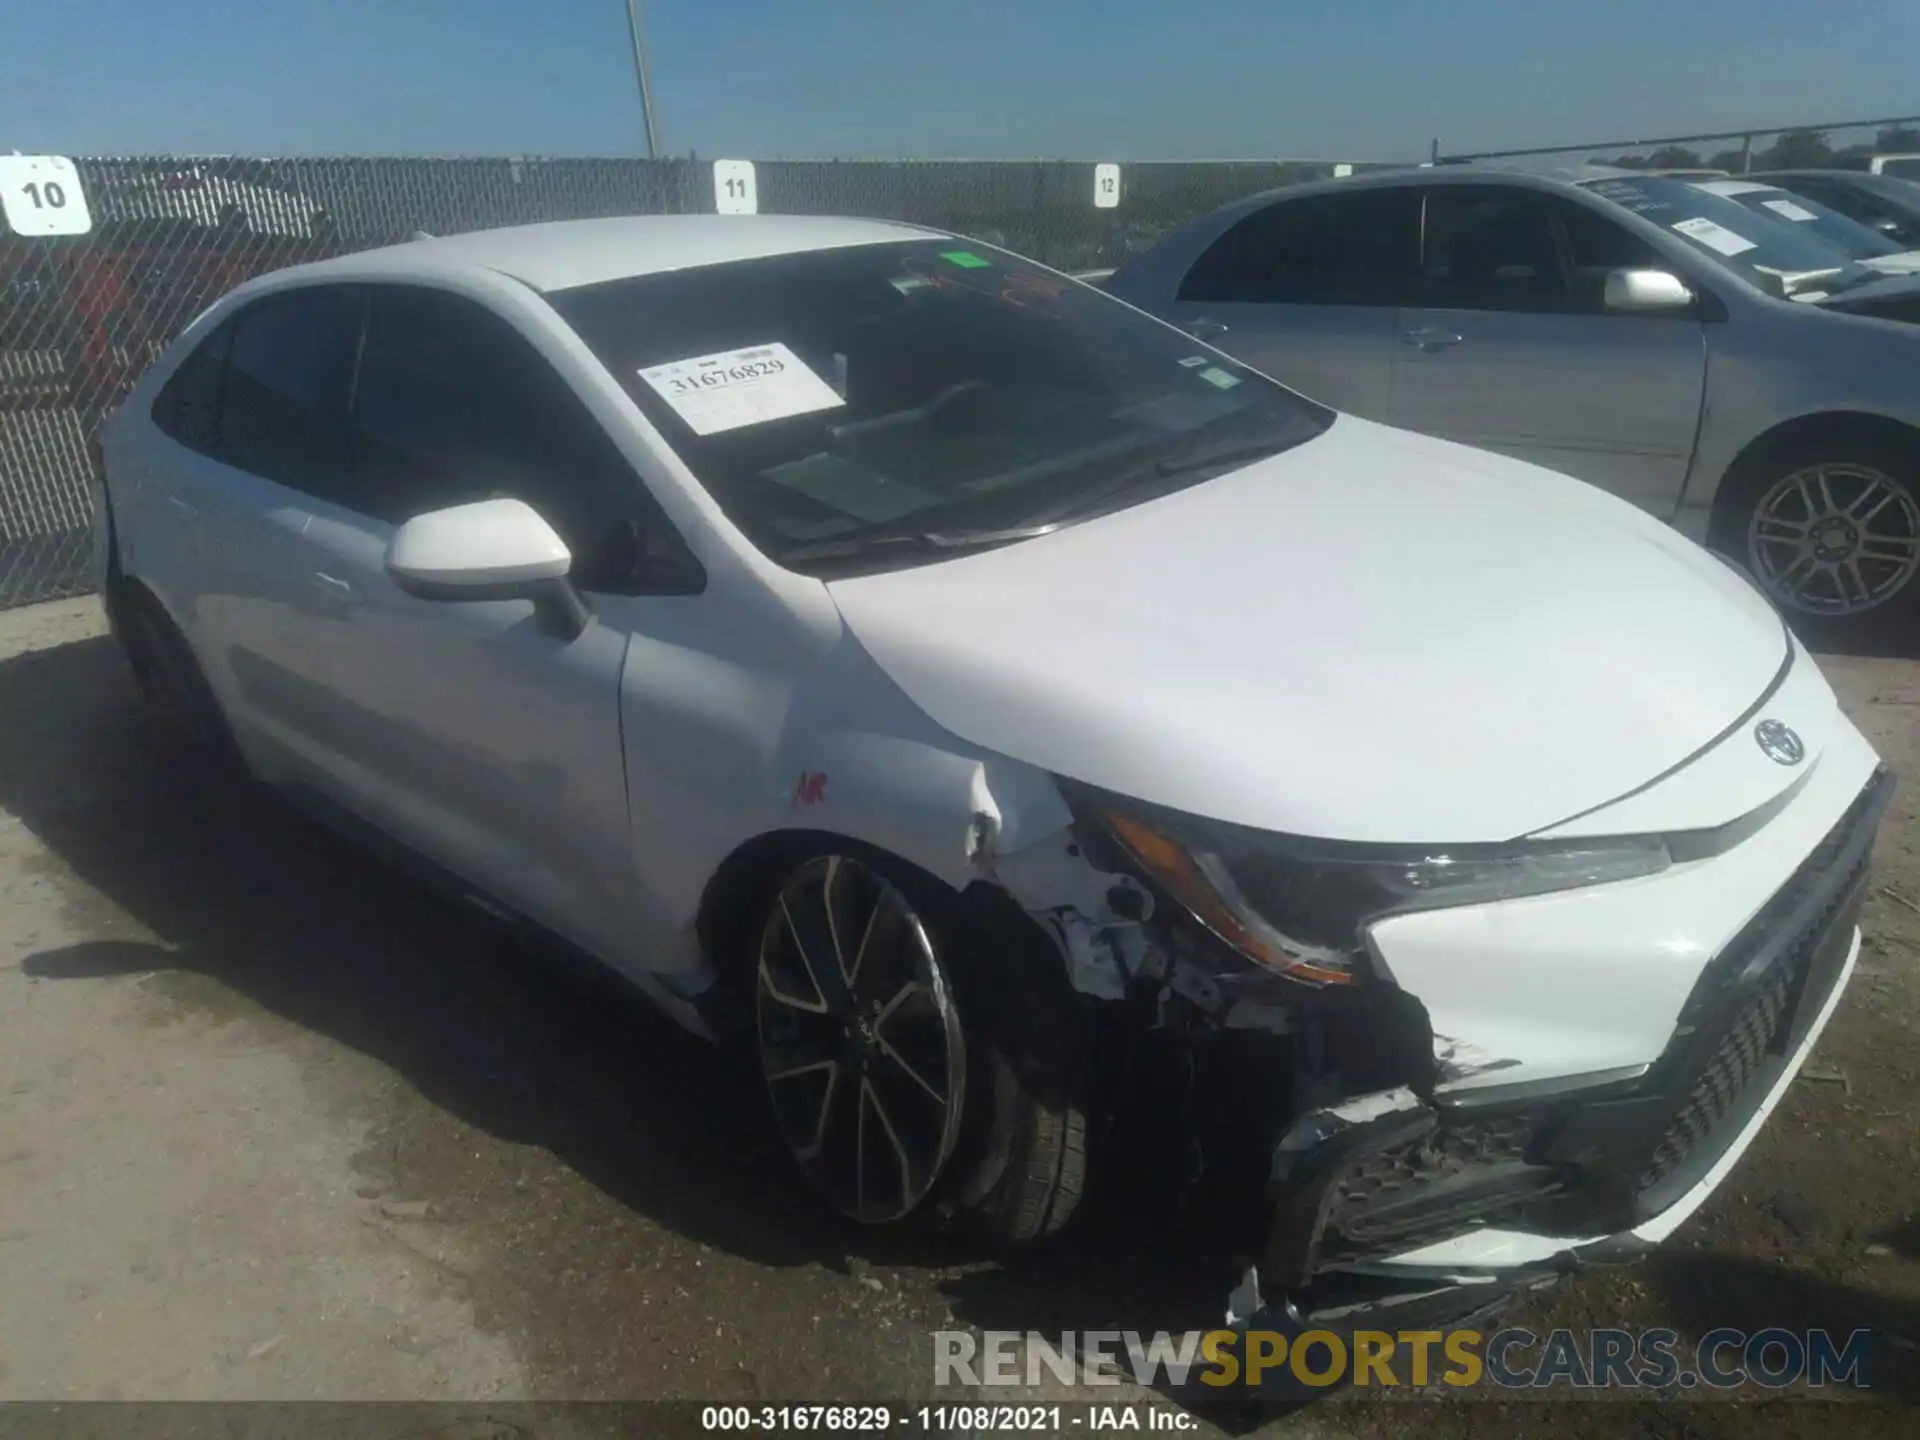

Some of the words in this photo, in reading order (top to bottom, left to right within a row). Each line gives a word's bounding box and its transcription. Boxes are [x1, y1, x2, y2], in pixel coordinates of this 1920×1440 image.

[21, 181, 66, 209] 10
[725, 178, 745, 198] 11
[1101, 178, 1114, 193] 12
[668, 358, 786, 393] 31676829
